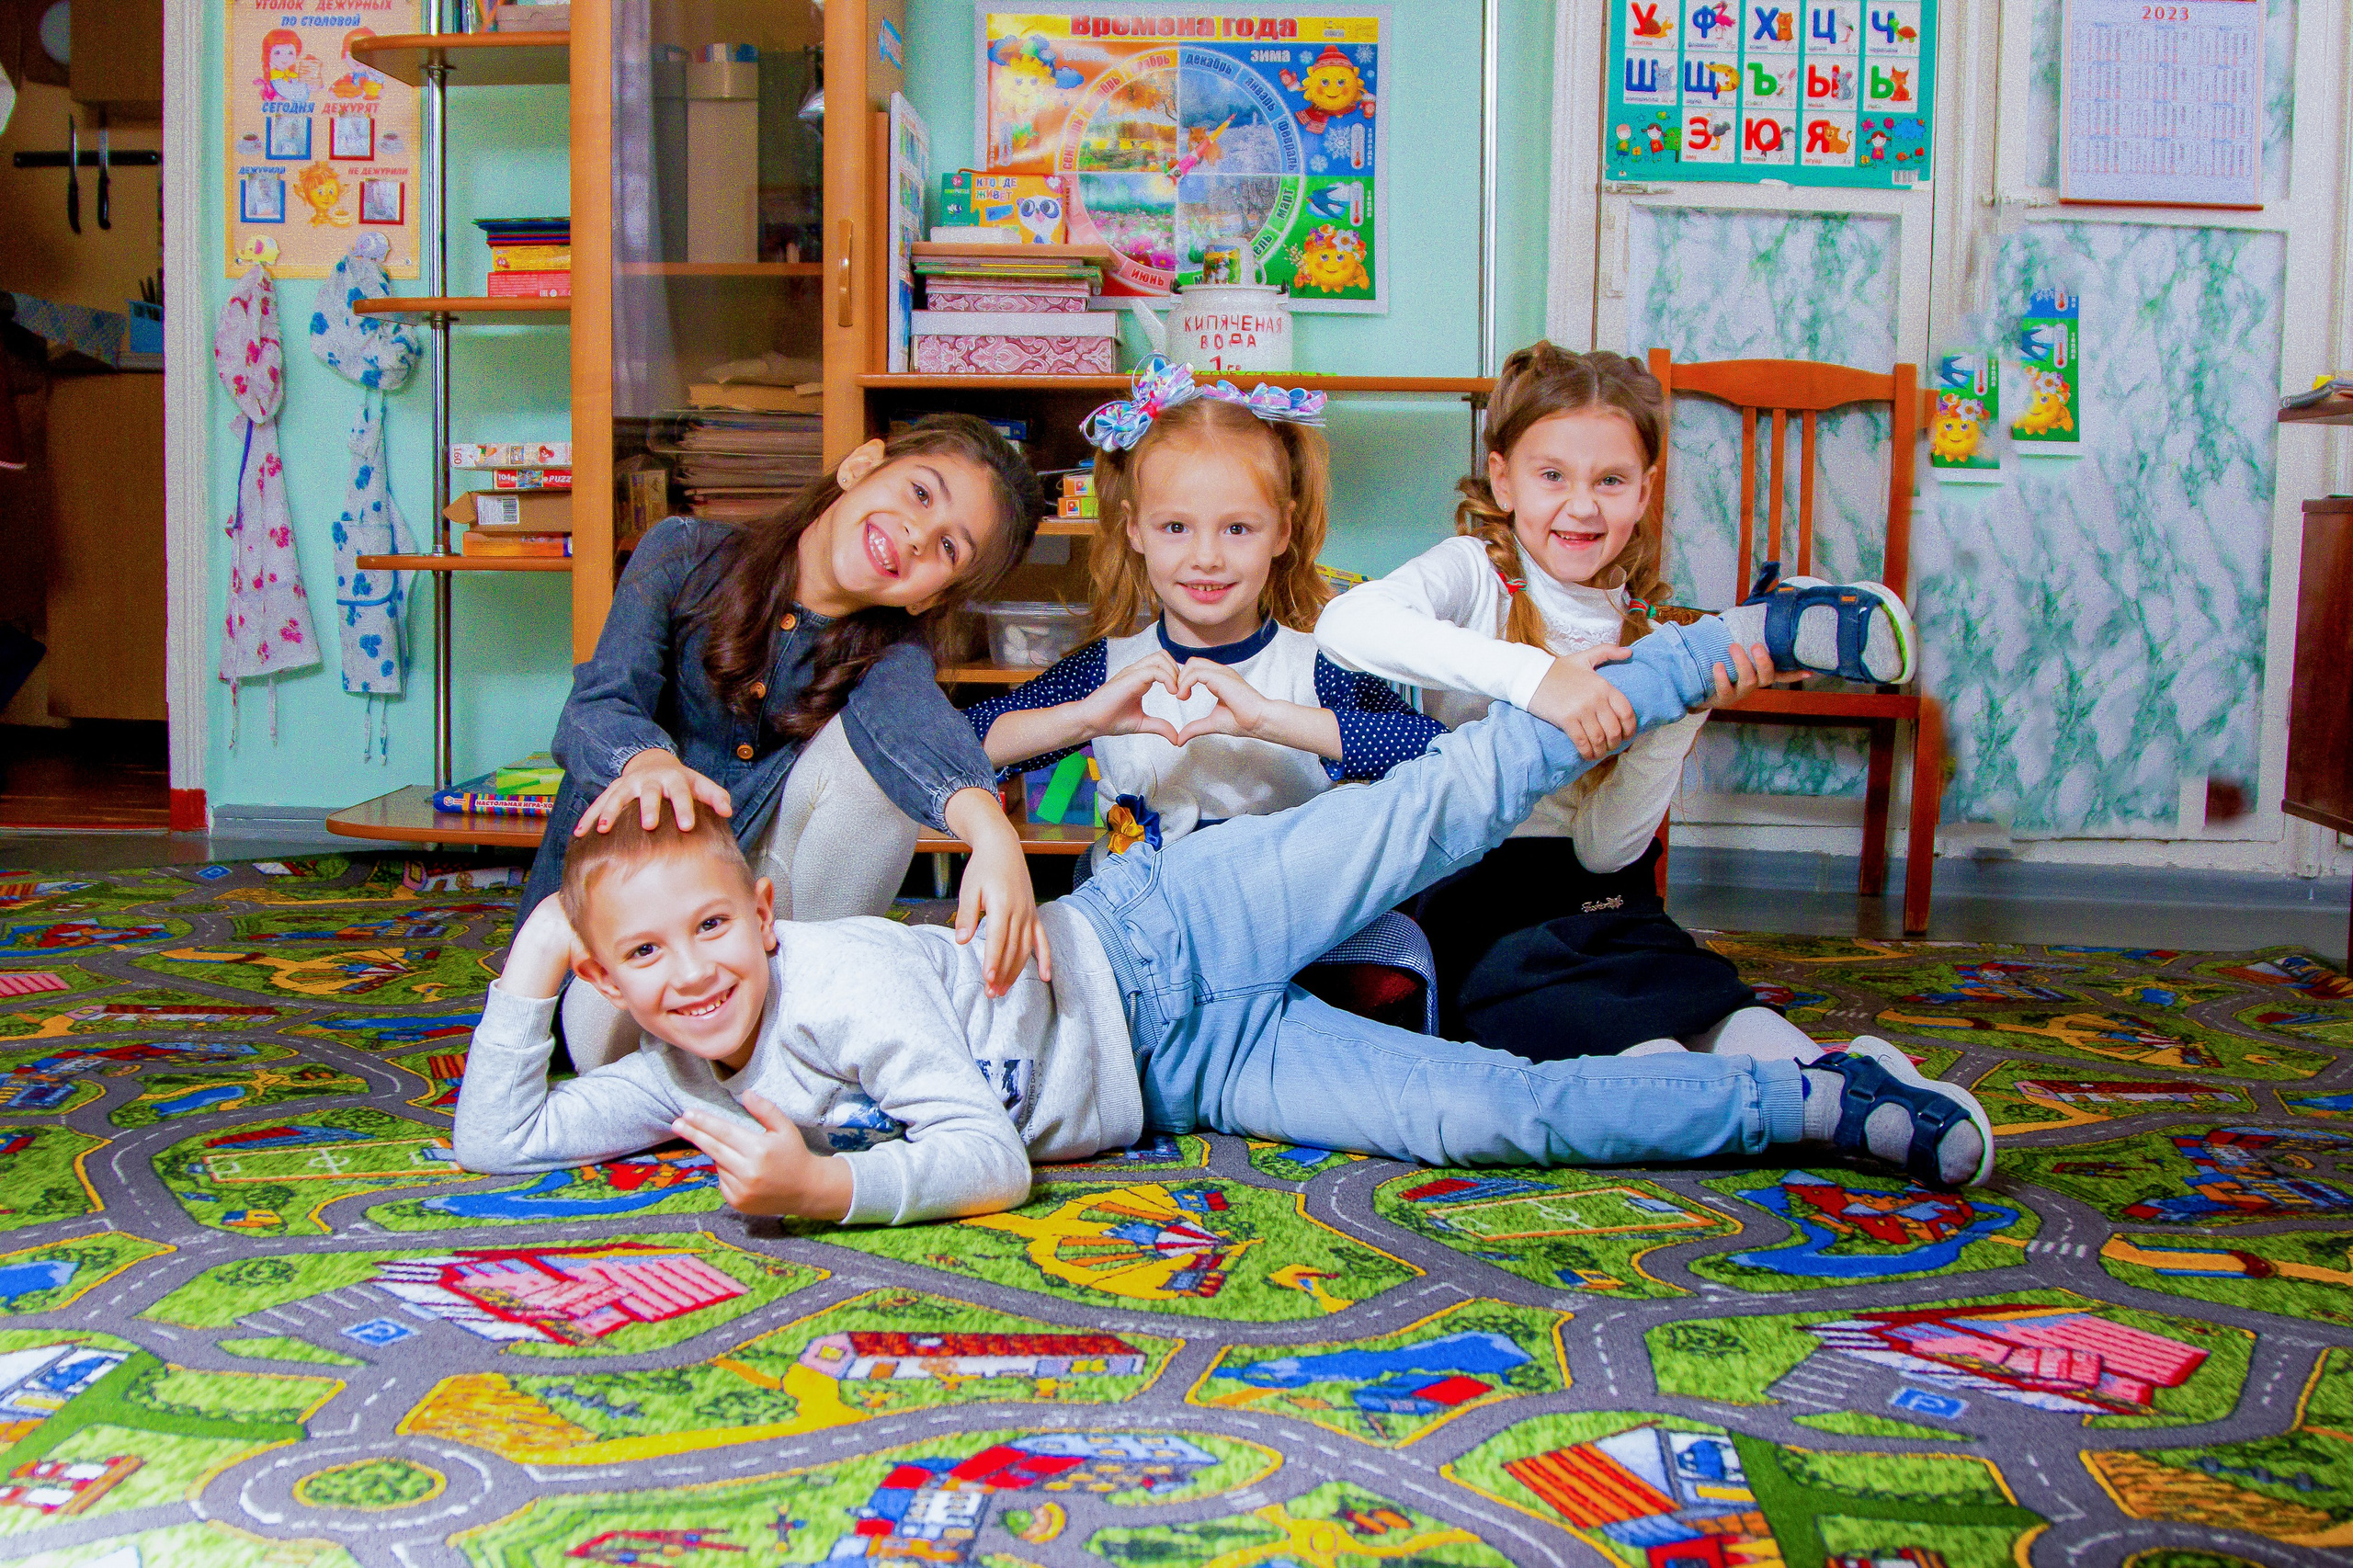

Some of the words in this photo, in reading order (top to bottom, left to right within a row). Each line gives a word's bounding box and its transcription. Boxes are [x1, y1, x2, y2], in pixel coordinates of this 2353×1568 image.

[280, 16, 297, 26] ПО
[1222, 17, 1298, 40] года
[1692, 5, 1717, 38] Ф
[1753, 6, 1779, 40] Х
[1813, 8, 1836, 44] Ц
[1871, 10, 1895, 43] Ч
[2142, 6, 2190, 21] 2023
[1186, 52, 1233, 75] декабрь
[1625, 58, 1658, 92] Ш
[1747, 62, 1778, 96] Ъ
[1245, 76, 1277, 112] январь
[1685, 61, 1719, 100] Щ
[1807, 64, 1840, 98] Ы
[1870, 65, 1894, 99] Ь
[261, 101, 315, 114] СЕГОДНЯ
[322, 102, 380, 115] ДЕЖУРЯТ
[1277, 118, 1298, 172] февраль
[1745, 117, 1781, 152] Ю
[1805, 119, 1831, 153] Я
[975, 177, 996, 187] КТО
[1276, 188, 1294, 220] март
[1131, 268, 1165, 286] июнь
[1184, 314, 1282, 334] КИПЯЧЕНАЯ
[1200, 333, 1256, 349] ВОДА
[1210, 355, 1222, 370] 1
[453, 447, 462, 465] 160
